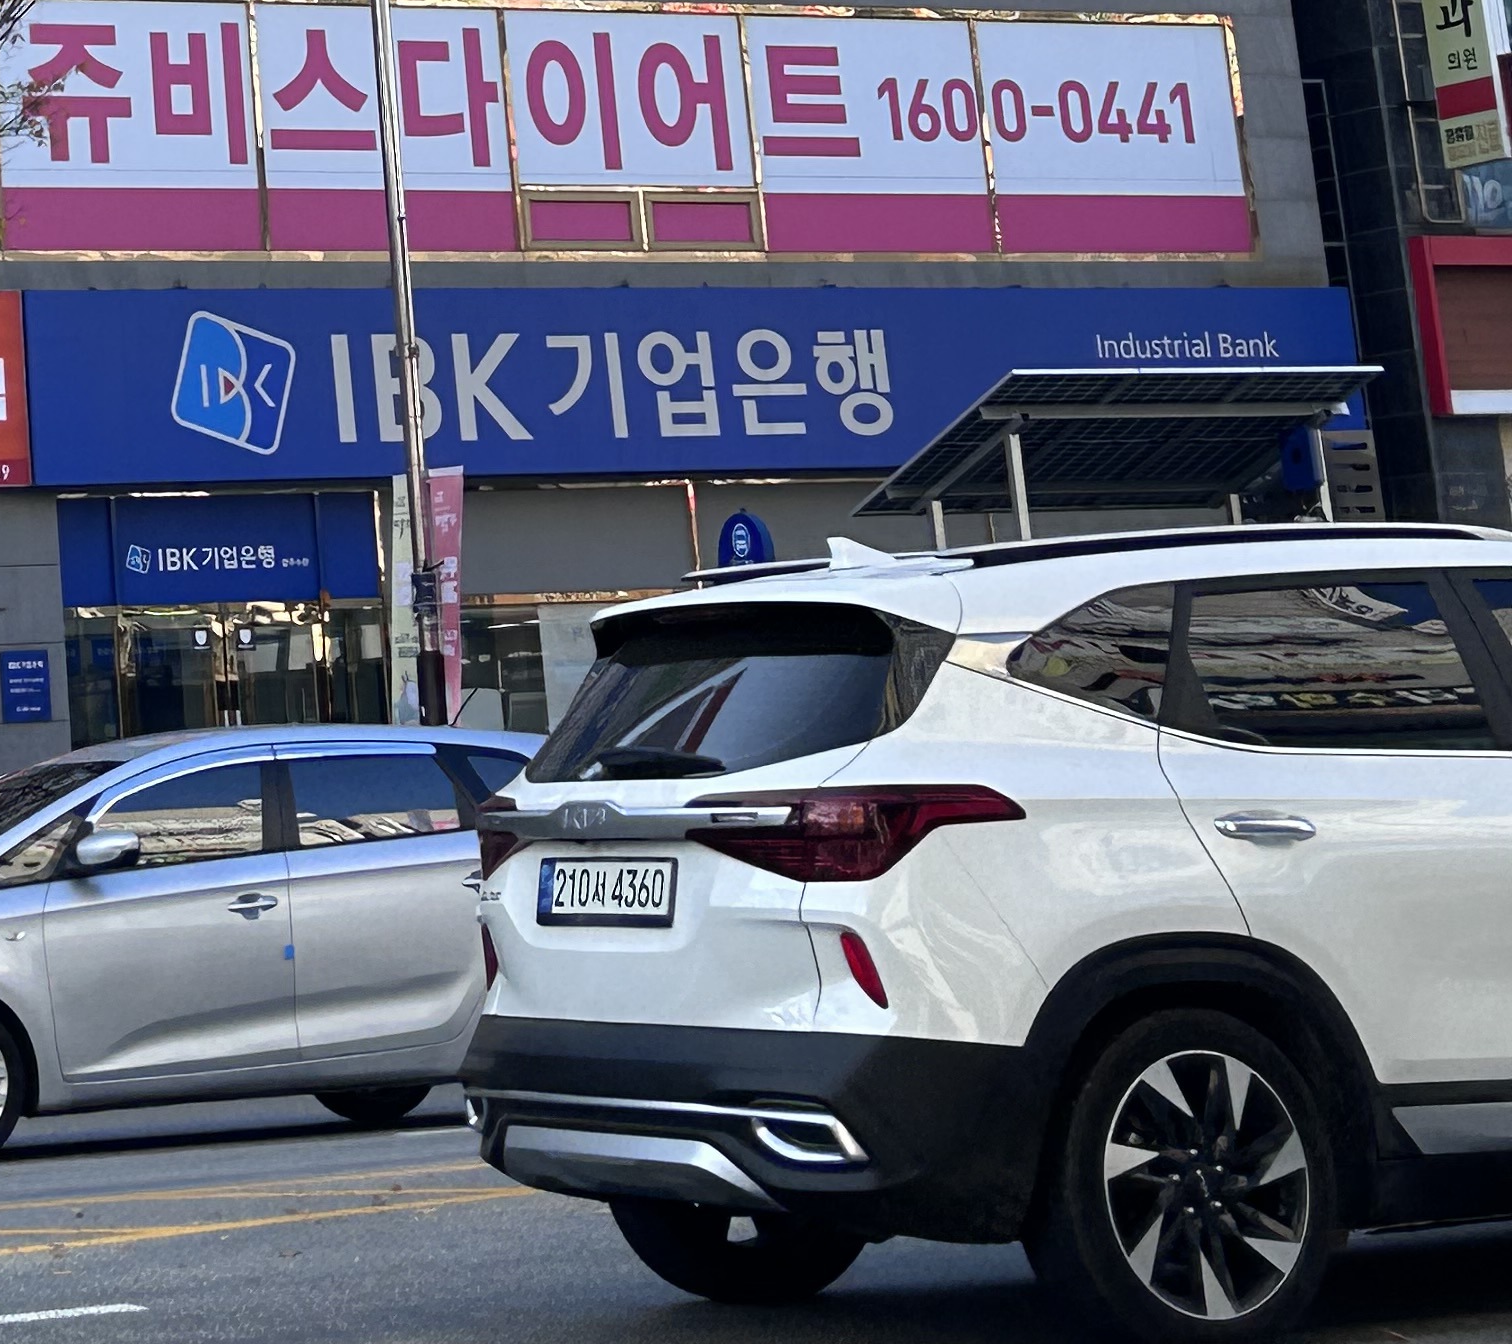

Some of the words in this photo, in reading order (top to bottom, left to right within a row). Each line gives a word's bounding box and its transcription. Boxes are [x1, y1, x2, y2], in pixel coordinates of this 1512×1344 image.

[1447, 47, 1479, 72] 의원
[23, 22, 861, 173] 쥬비스다이어트
[877, 77, 1197, 145] 1600-0441
[1096, 332, 1211, 360] Industrial
[1218, 331, 1280, 360] Bank
[610, 868, 665, 909] 4360
